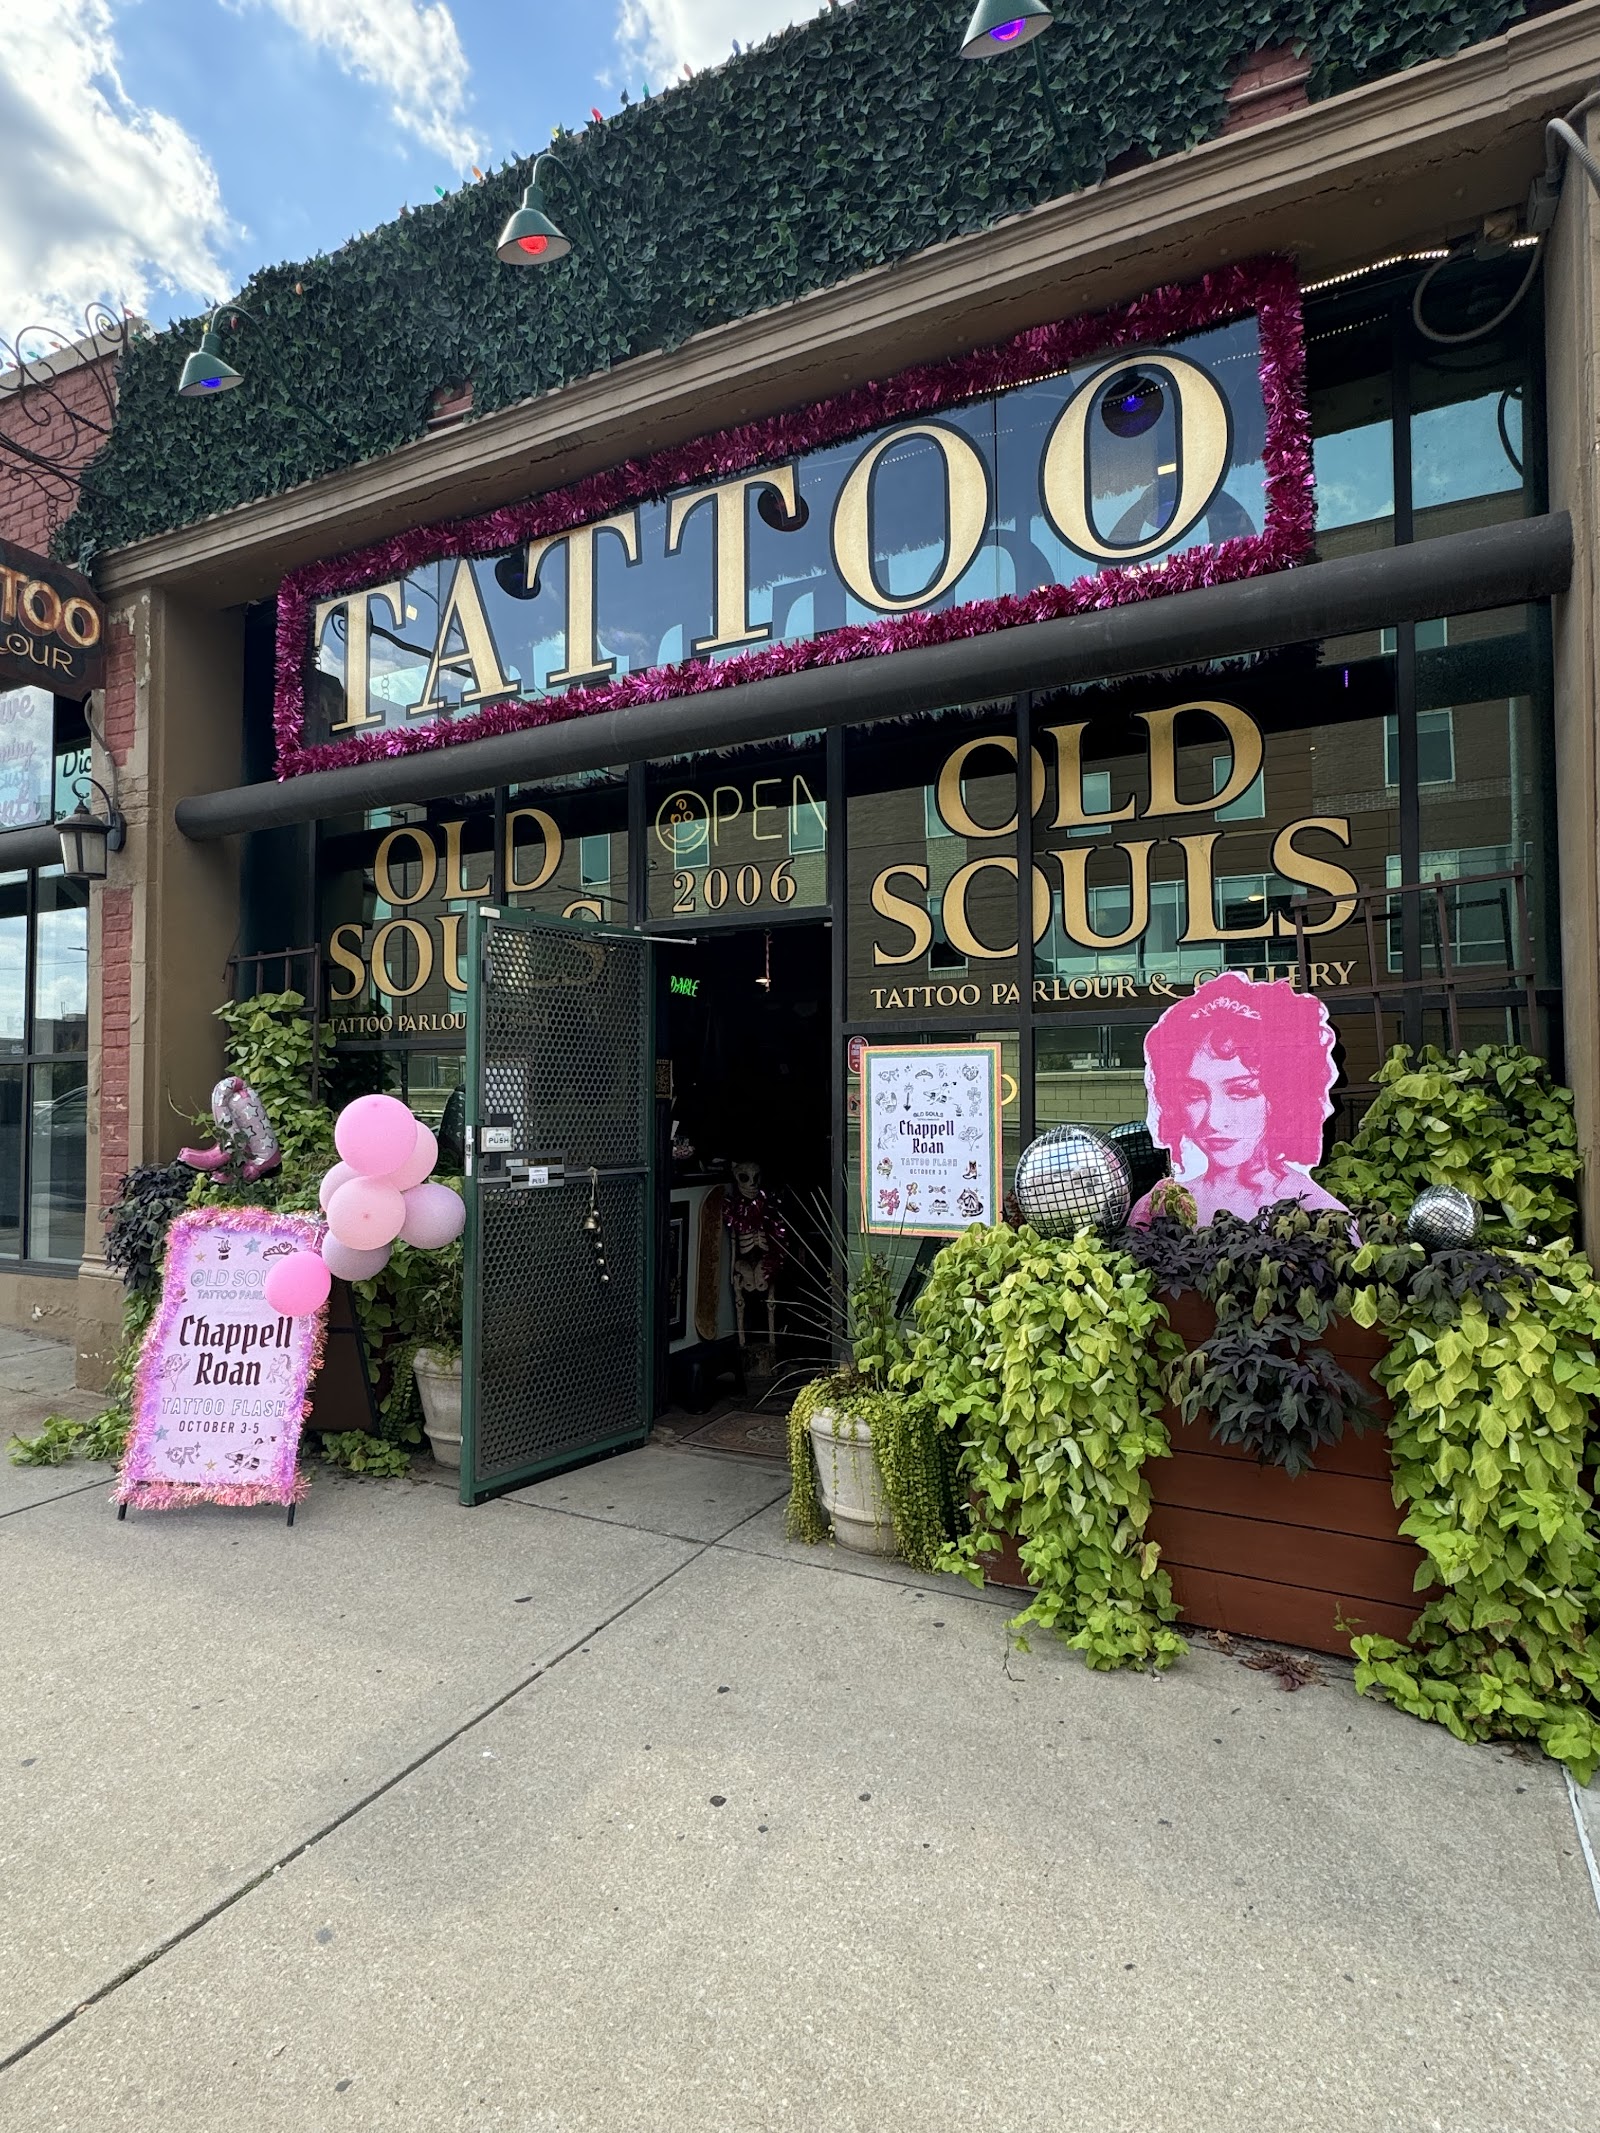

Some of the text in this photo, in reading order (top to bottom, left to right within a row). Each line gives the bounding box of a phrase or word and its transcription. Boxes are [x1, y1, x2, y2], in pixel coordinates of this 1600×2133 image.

[313, 351, 1231, 734] TATTOO
[936, 700, 1265, 838] OLD
[655, 774, 828, 854] OPEN
[374, 807, 562, 905] OLD
[671, 857, 798, 913] 2006
[871, 817, 1359, 967] SOULS
[870, 983, 980, 1010] TATTOO
[991, 972, 1138, 1006] PARLOUR
[1149, 970, 1192, 999] &
[327, 1016, 393, 1034] TATTOO
[899, 1120, 954, 1139] Chappell
[911, 1137, 944, 1154] Roan
[901, 1157, 930, 1167] TATTOO
[909, 1168, 936, 1176] OCTOBER
[191, 1269, 230, 1287] OLD
[197, 1289, 238, 1300] TATTOO
[179, 1314, 293, 1355] Chappell
[193, 1352, 262, 1386] Roan
[161, 1397, 286, 1417] TATTOO FLASH
[178, 1420, 260, 1435] OCTOBER 3-5
